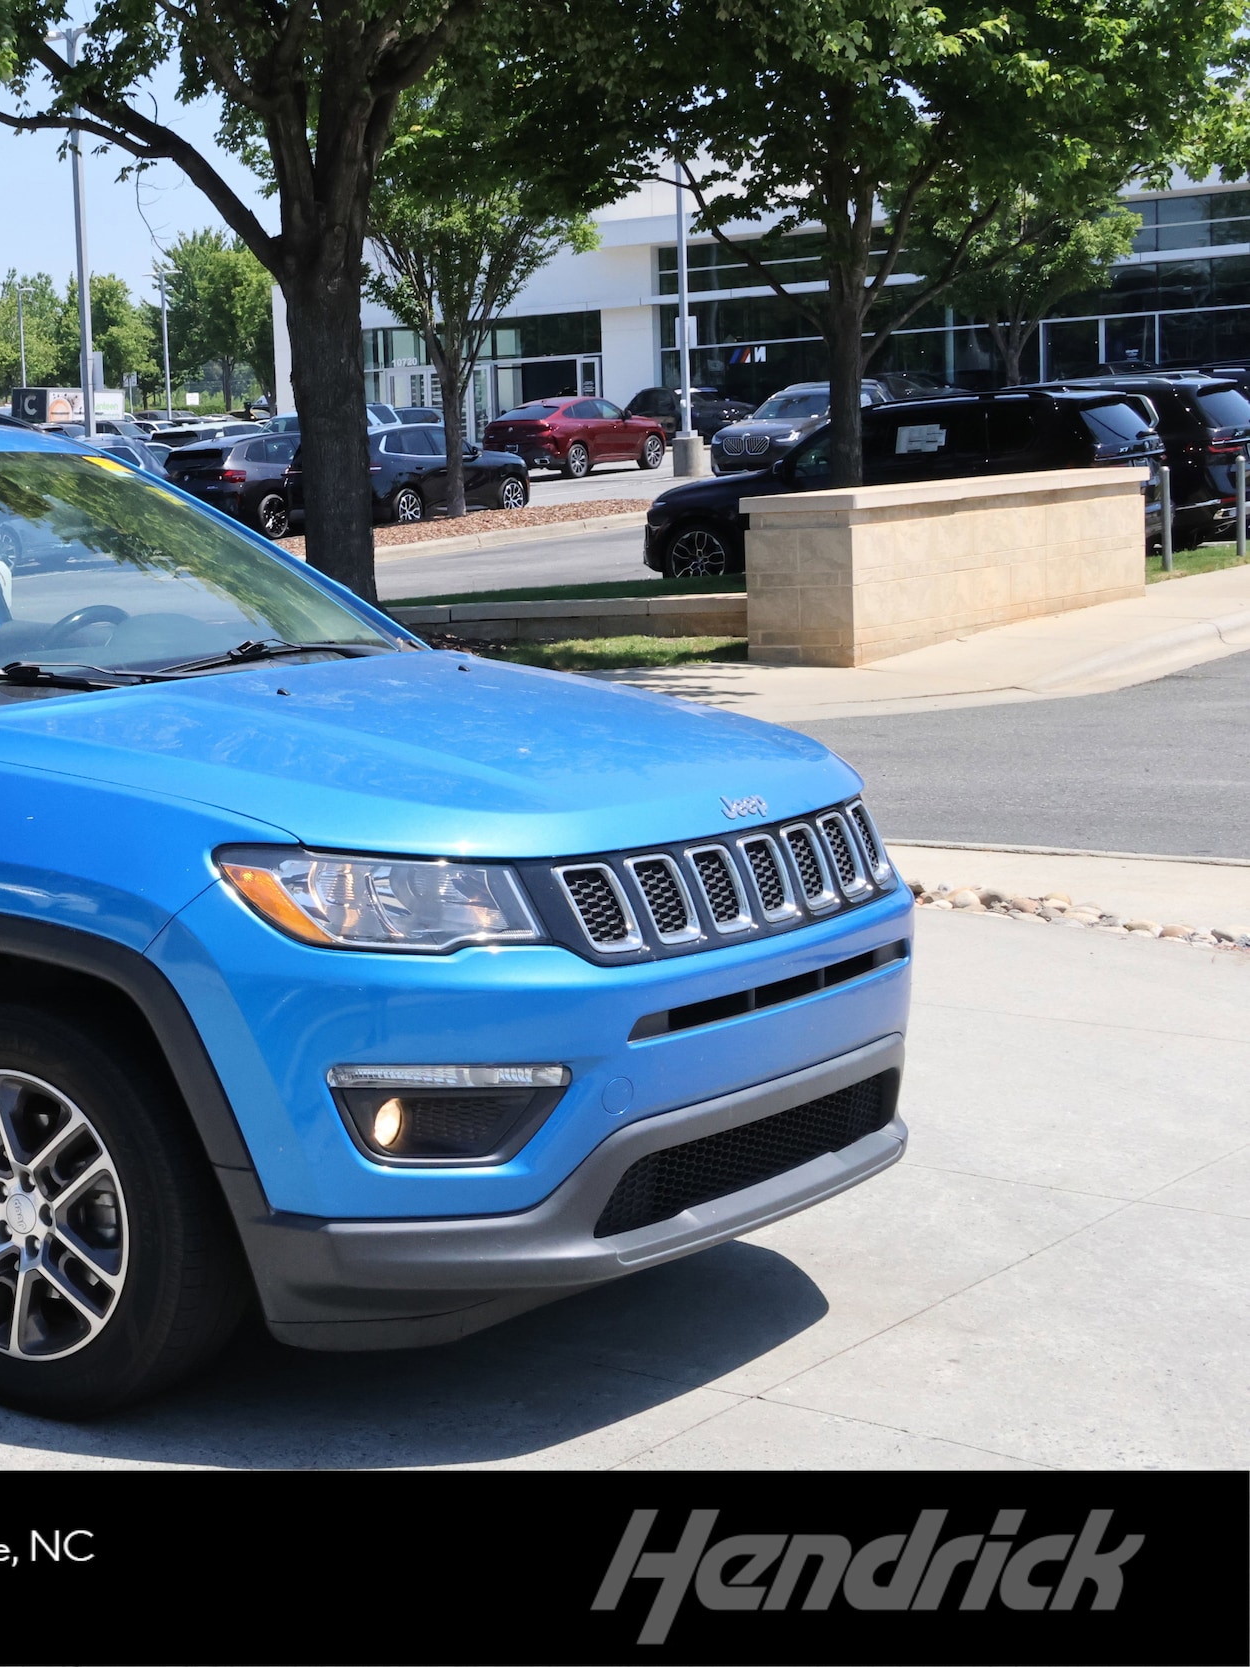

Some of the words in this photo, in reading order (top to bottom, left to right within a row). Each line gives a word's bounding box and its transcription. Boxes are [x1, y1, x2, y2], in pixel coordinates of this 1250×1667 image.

[392, 357, 418, 367] 10720
[24, 395, 37, 415] C
[95, 402, 119, 411] anteen
[719, 794, 767, 820] Jeep
